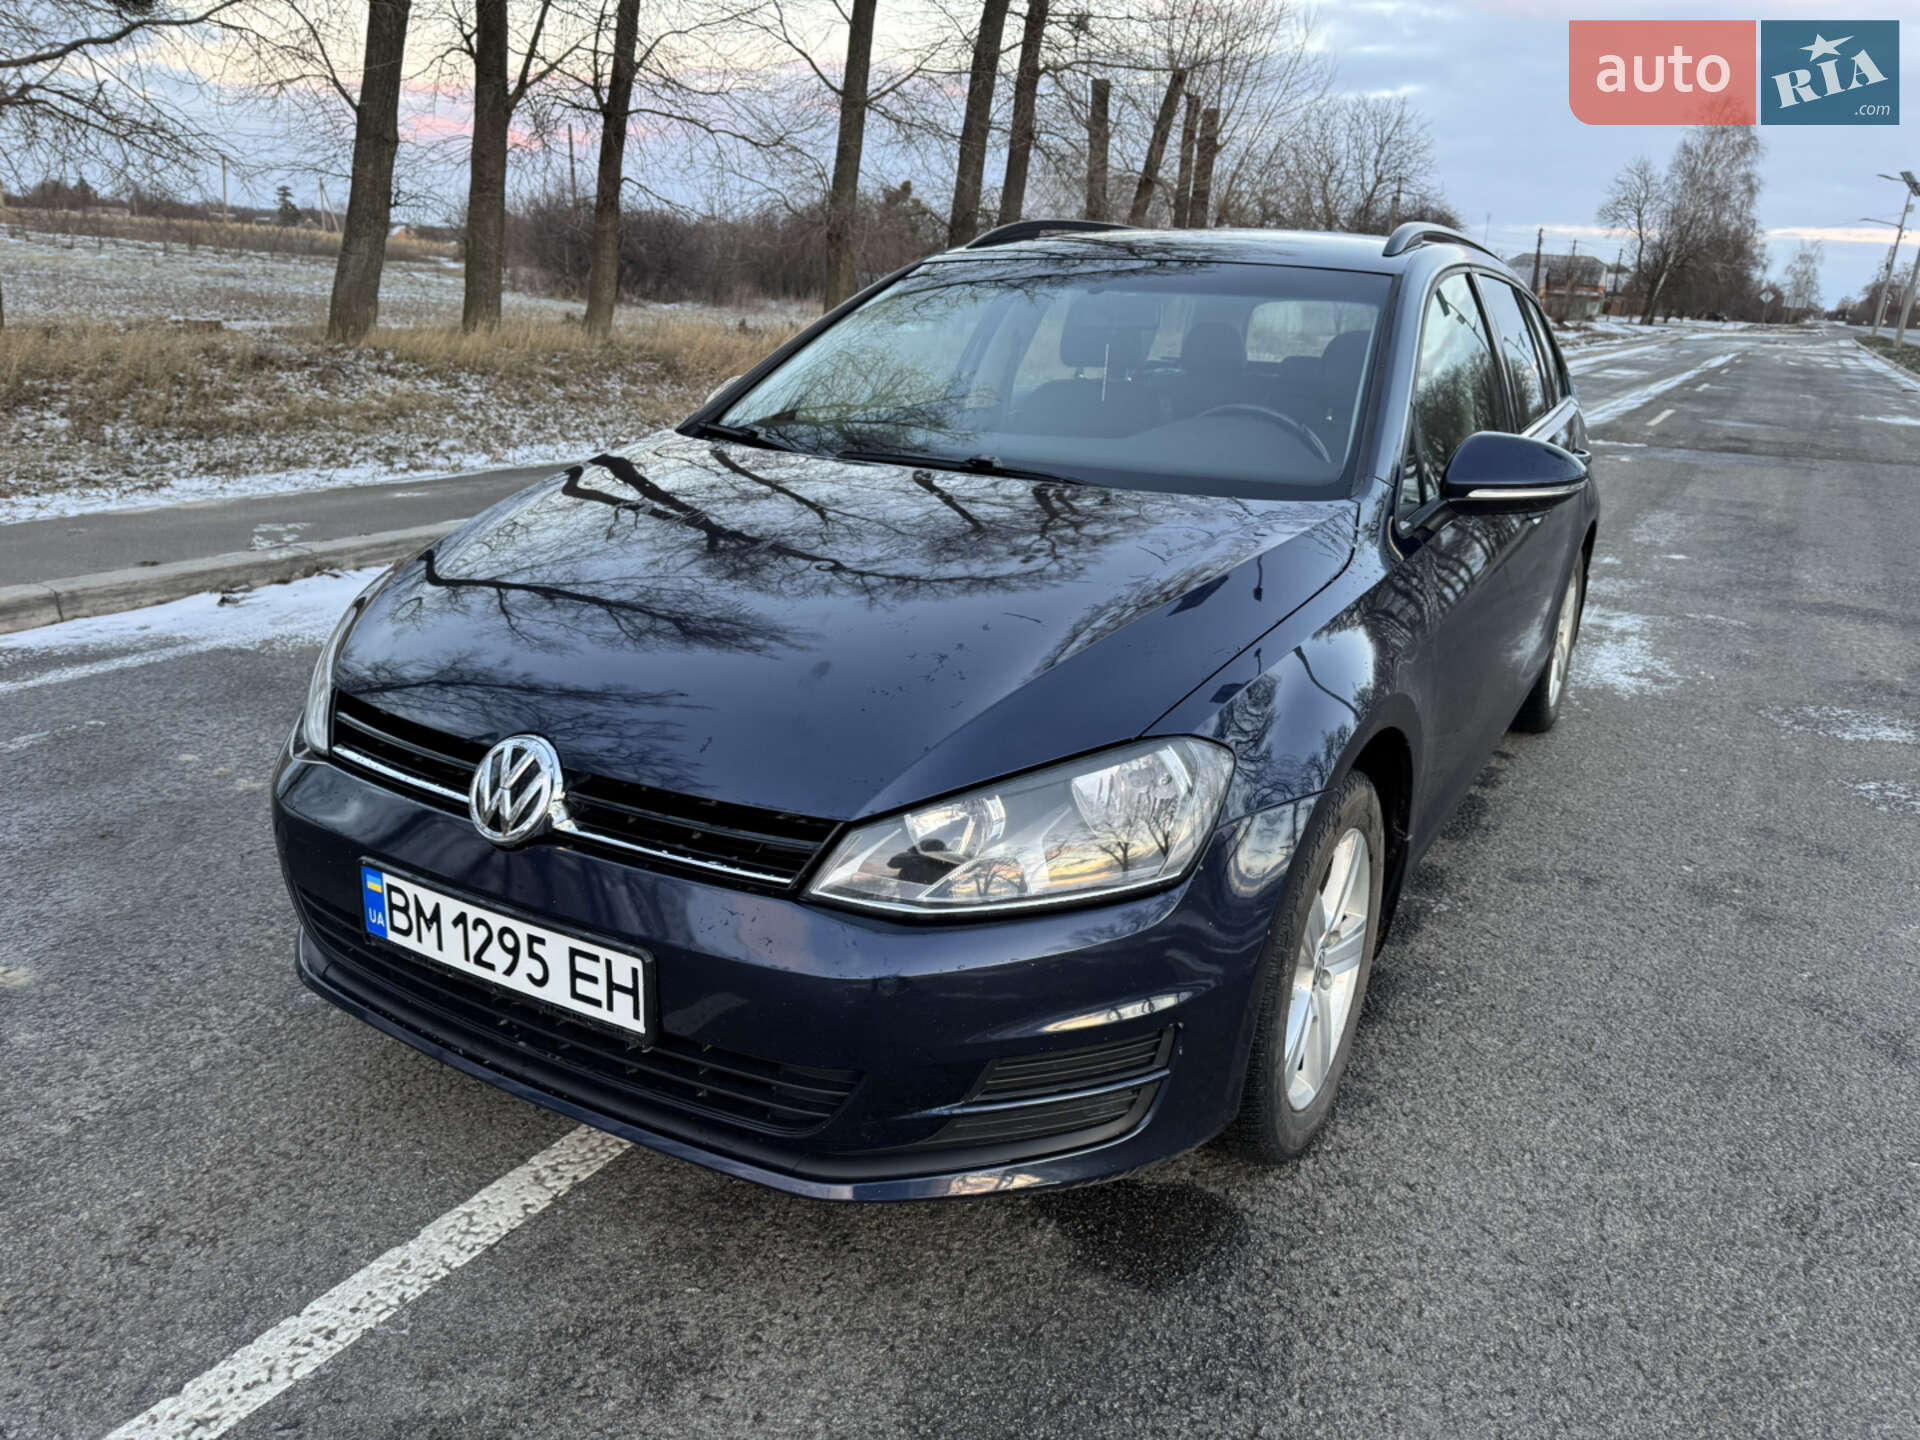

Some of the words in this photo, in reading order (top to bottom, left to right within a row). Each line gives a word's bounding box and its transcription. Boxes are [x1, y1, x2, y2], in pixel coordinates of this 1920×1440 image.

[368, 907, 385, 928] UA
[386, 882, 443, 951] BM
[451, 911, 550, 988] 1295
[568, 946, 641, 1021] EH
